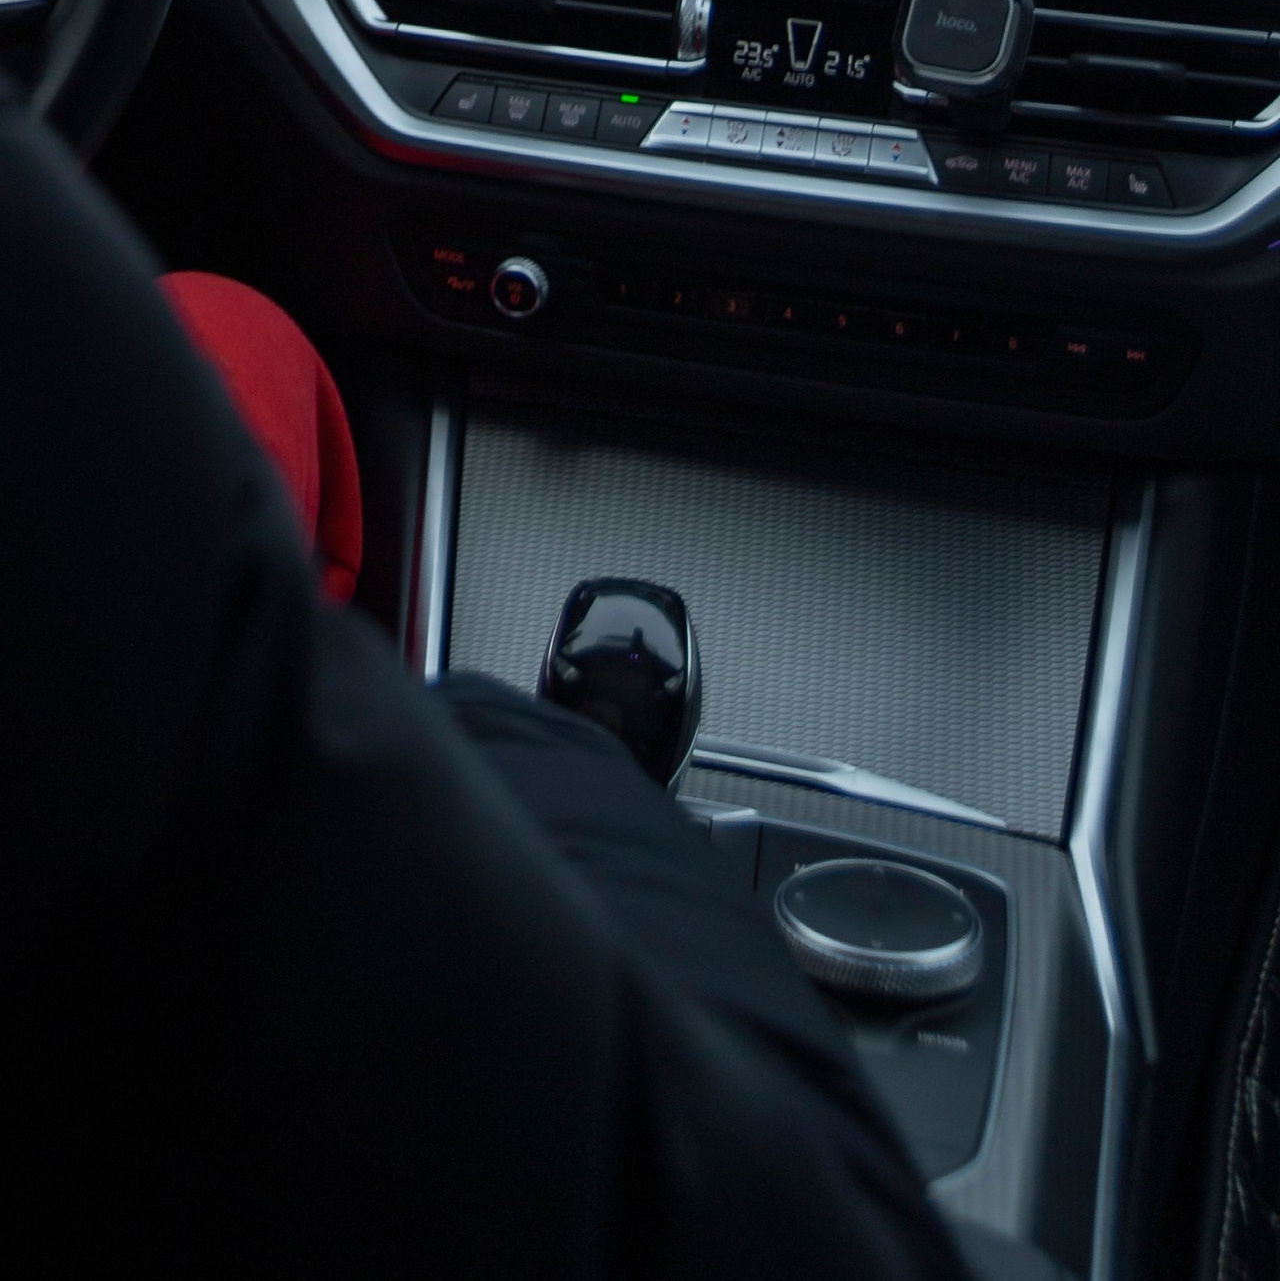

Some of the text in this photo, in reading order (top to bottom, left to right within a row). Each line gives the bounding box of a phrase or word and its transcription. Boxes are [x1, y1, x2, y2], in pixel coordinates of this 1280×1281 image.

[741, 67, 763, 82] A/C
[782, 71, 816, 88] AUTO
[558, 102, 587, 116] REAR
[610, 114, 642, 129] AUTO
[1004, 157, 1038, 173] MENU
[1065, 164, 1092, 179] MAX
[1066, 176, 1089, 191] A/C
